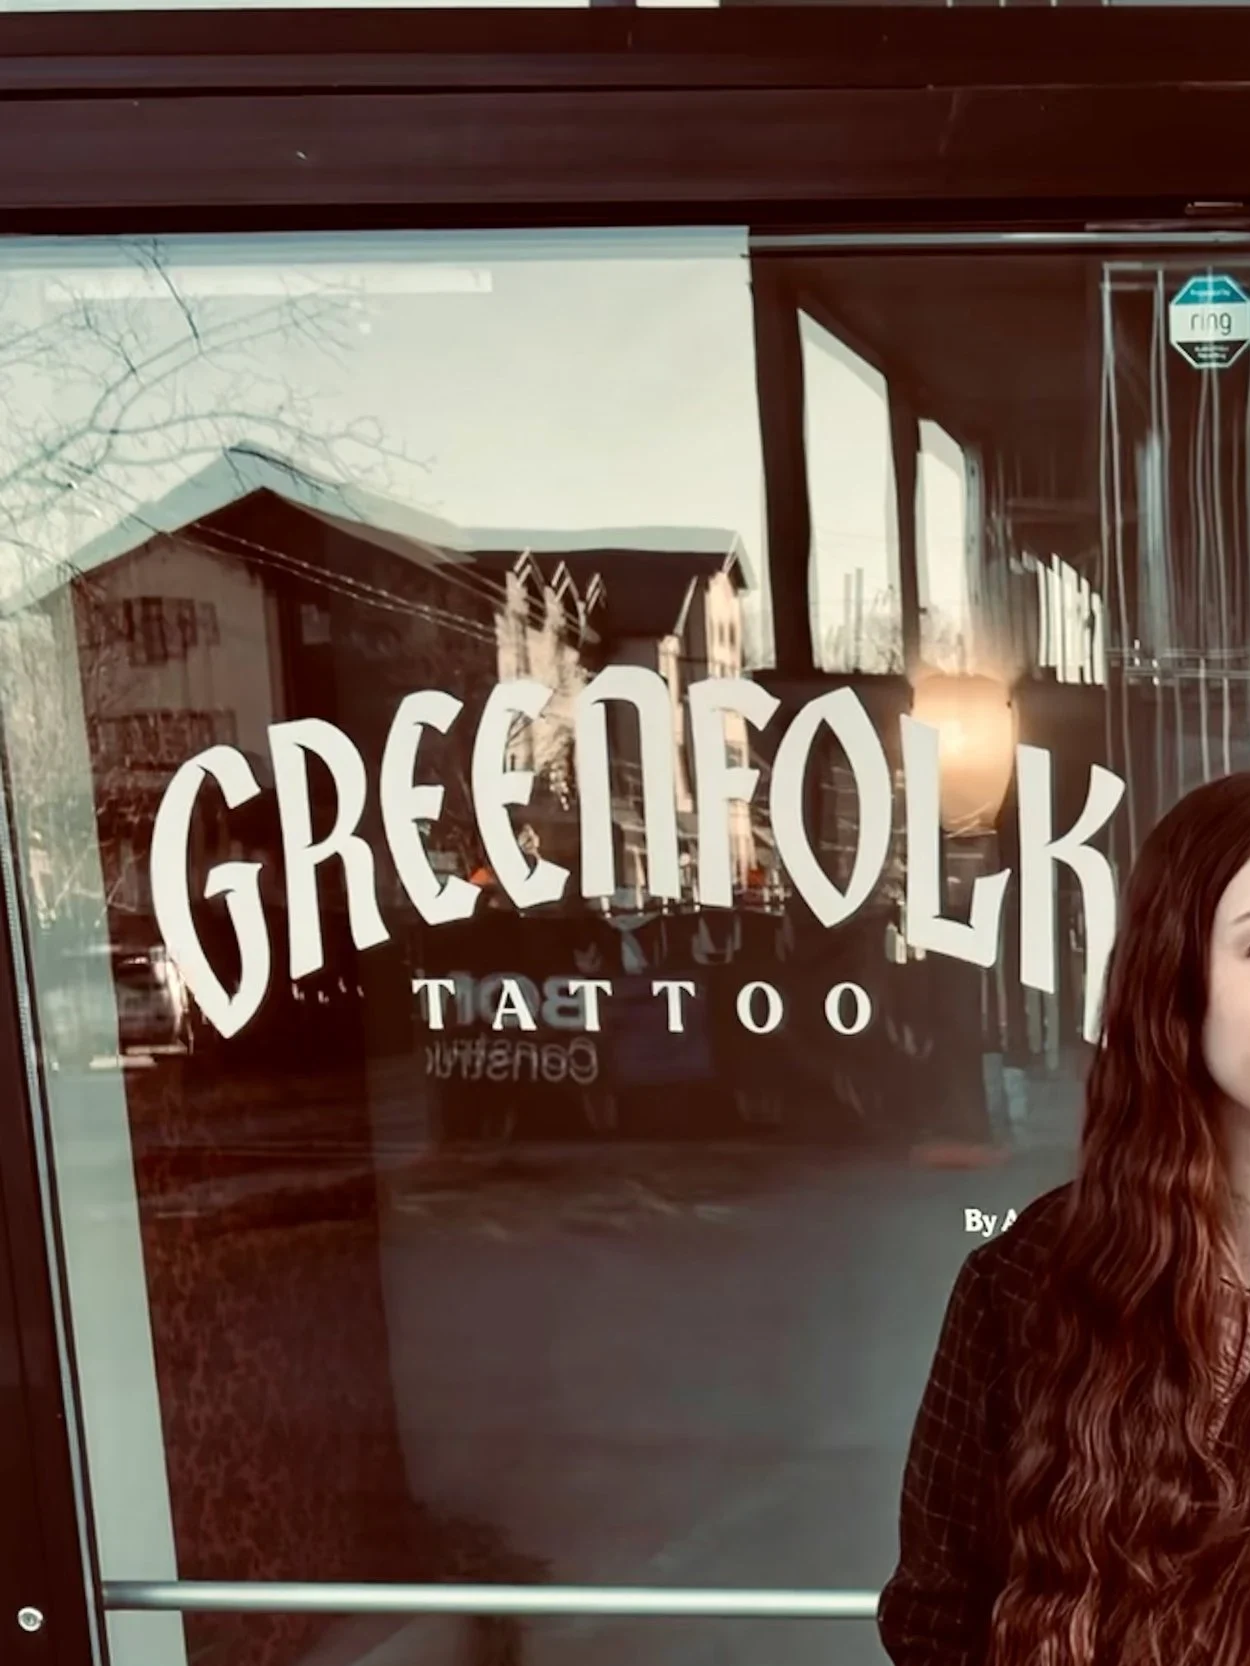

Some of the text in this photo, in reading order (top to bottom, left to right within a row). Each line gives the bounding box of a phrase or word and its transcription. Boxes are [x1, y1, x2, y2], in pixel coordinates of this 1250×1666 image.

[1190, 312, 1232, 336] ring
[150, 664, 1125, 1044] GREENFOLK
[412, 978, 872, 1035] TATTOO
[965, 1208, 997, 1237] By
